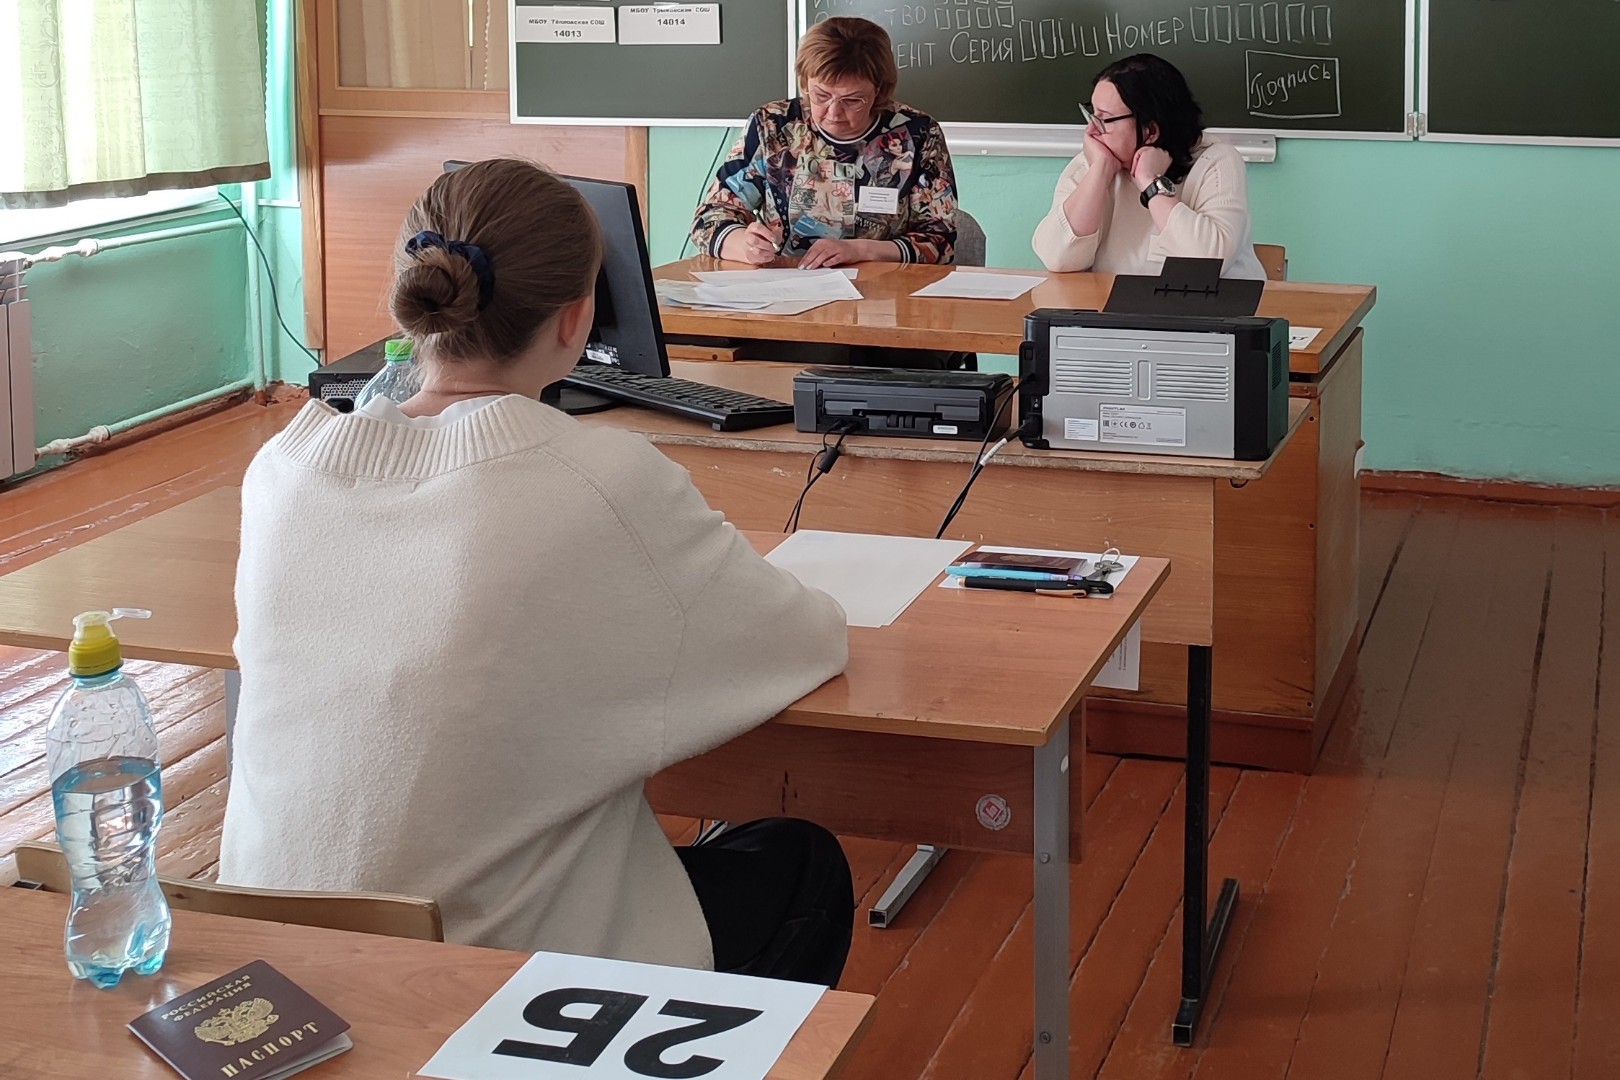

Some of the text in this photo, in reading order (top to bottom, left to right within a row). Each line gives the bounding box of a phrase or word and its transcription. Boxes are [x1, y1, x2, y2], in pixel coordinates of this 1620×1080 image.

[657, 18, 686, 26] 14014
[1250, 63, 1332, 109] Подпись
[161, 974, 251, 1020] РОССИЙСКАЯ
[173, 982, 252, 1022] ФЕДЕРАЦИЯ
[220, 1021, 320, 1079] ПАСПОРТ
